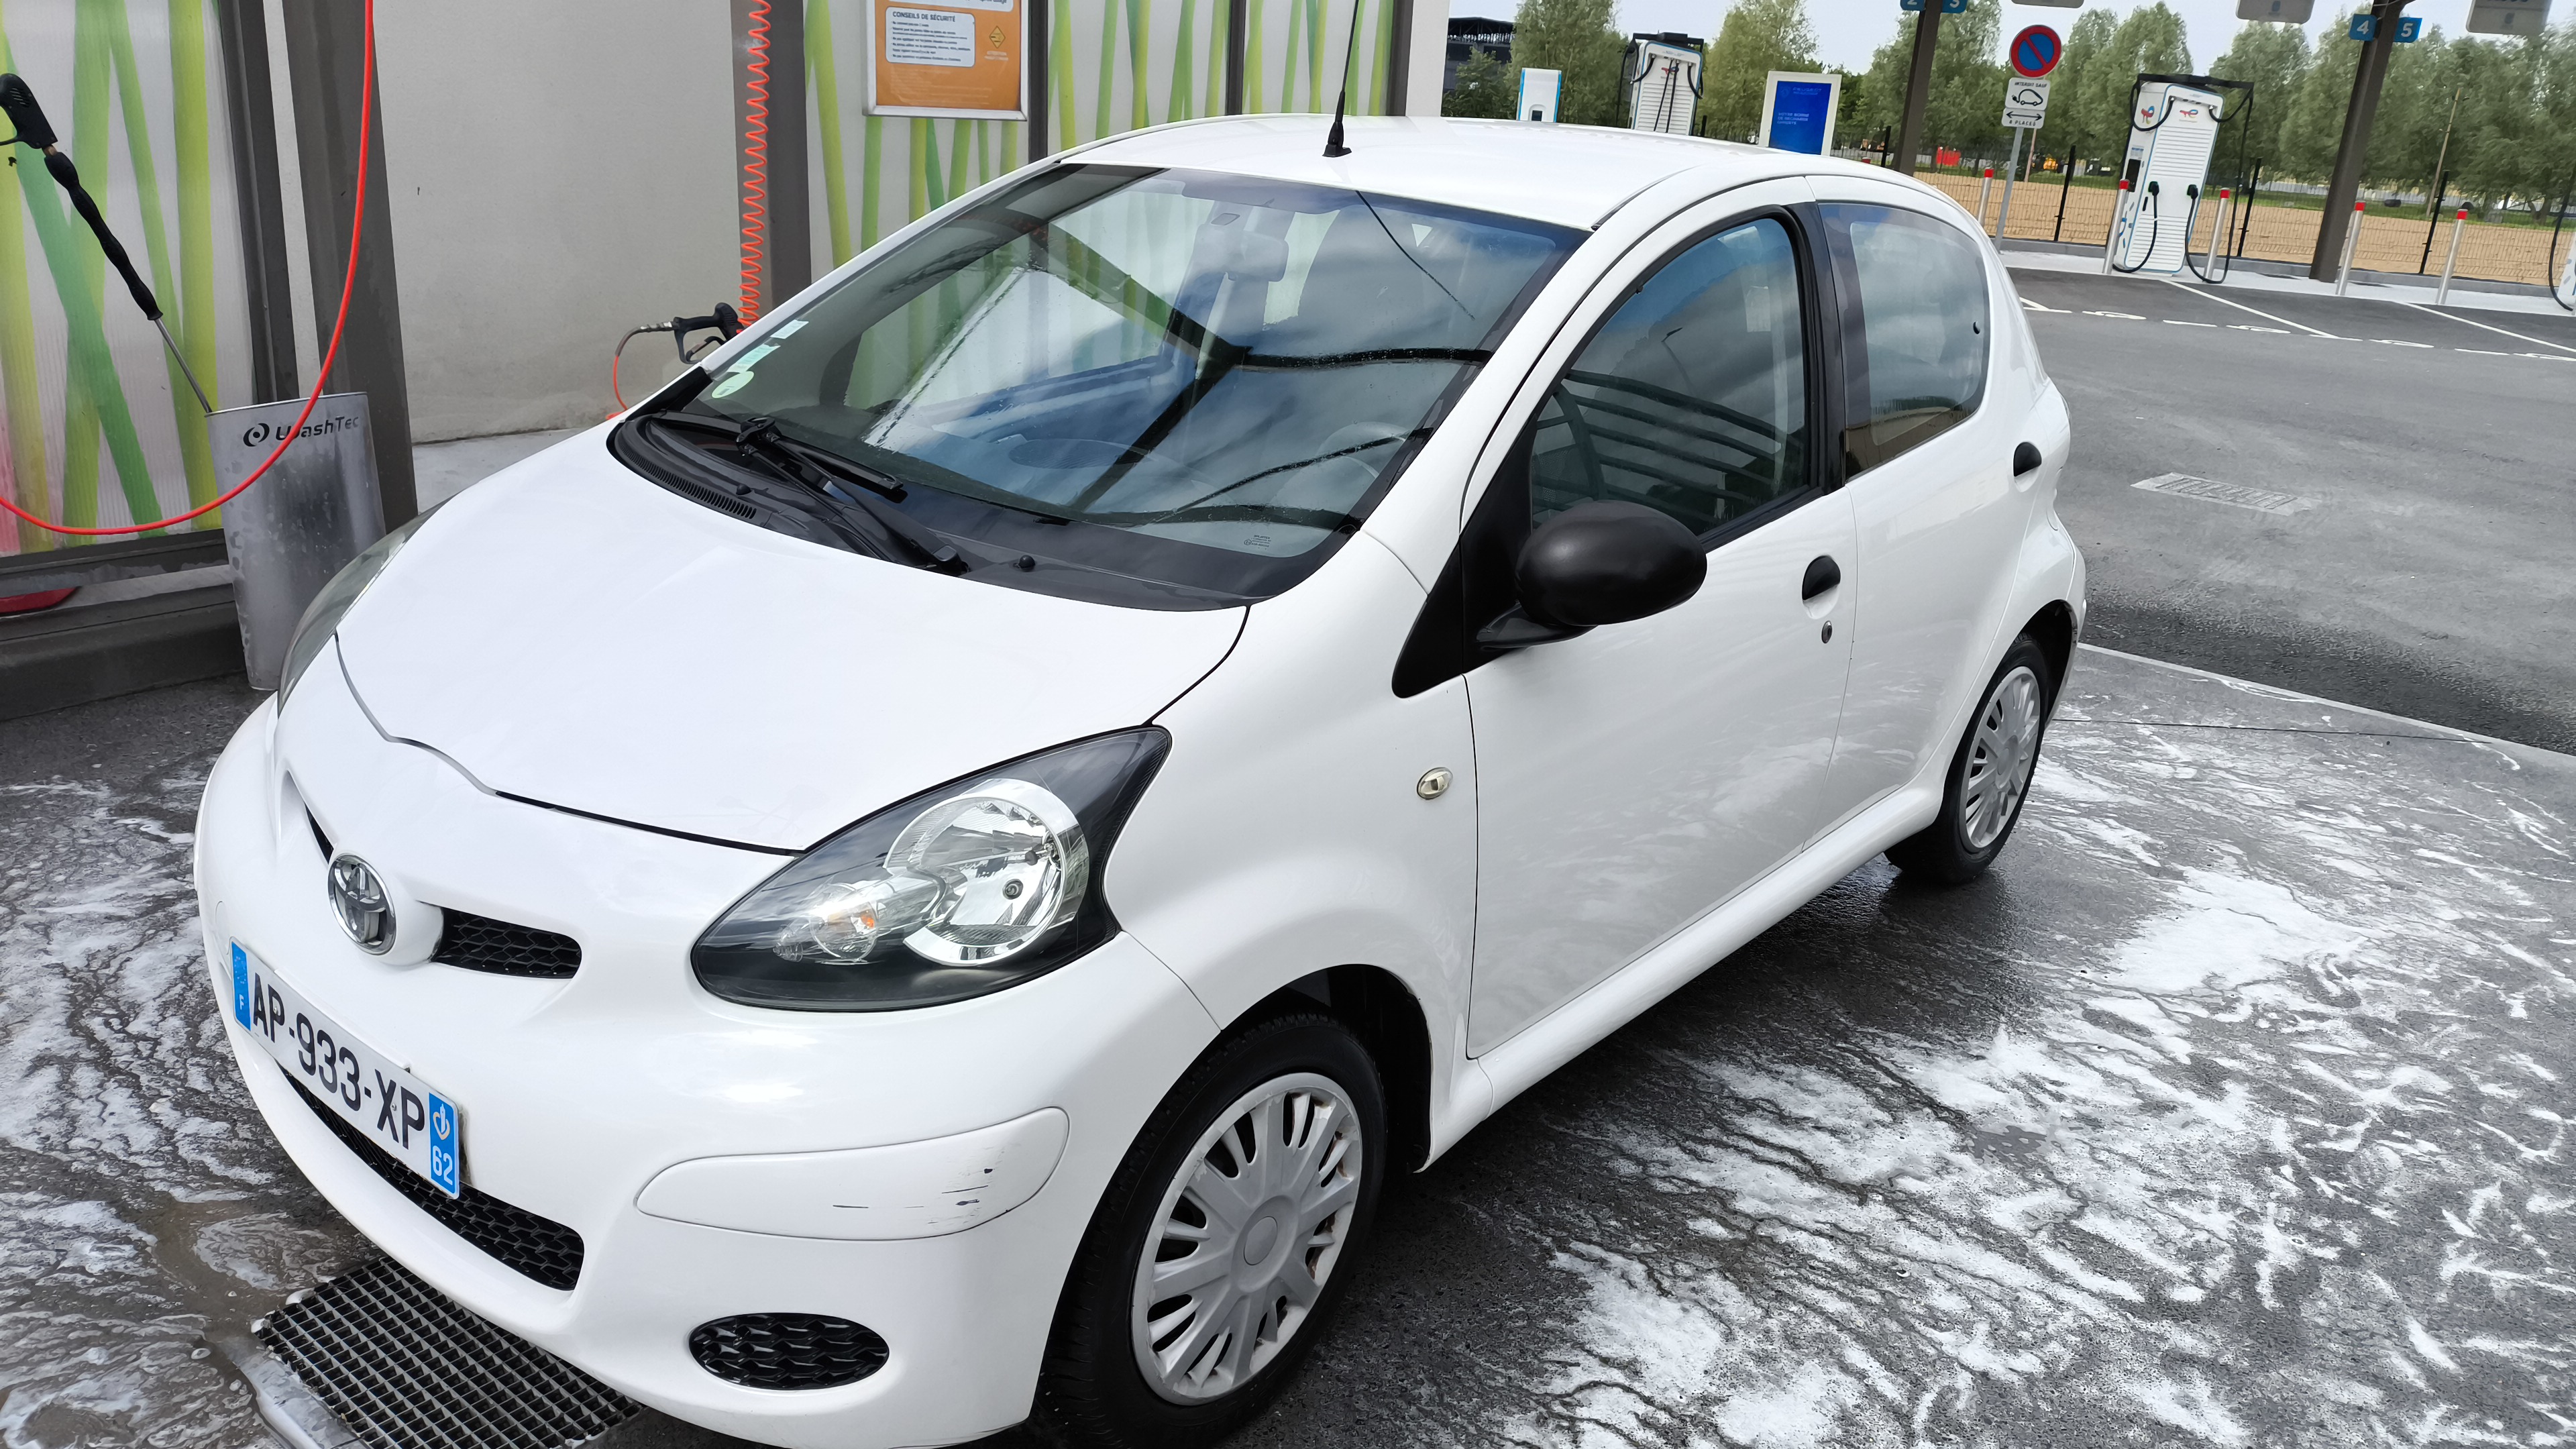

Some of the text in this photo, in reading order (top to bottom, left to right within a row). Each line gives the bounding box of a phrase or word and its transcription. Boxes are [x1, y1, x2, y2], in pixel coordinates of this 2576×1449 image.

[930, 13, 956, 22] SÉCURITÉ
[2357, 20, 2369, 35] 4
[2401, 23, 2414, 38] 5
[239, 994, 244, 1010] F
[432, 1145, 453, 1185] 62
